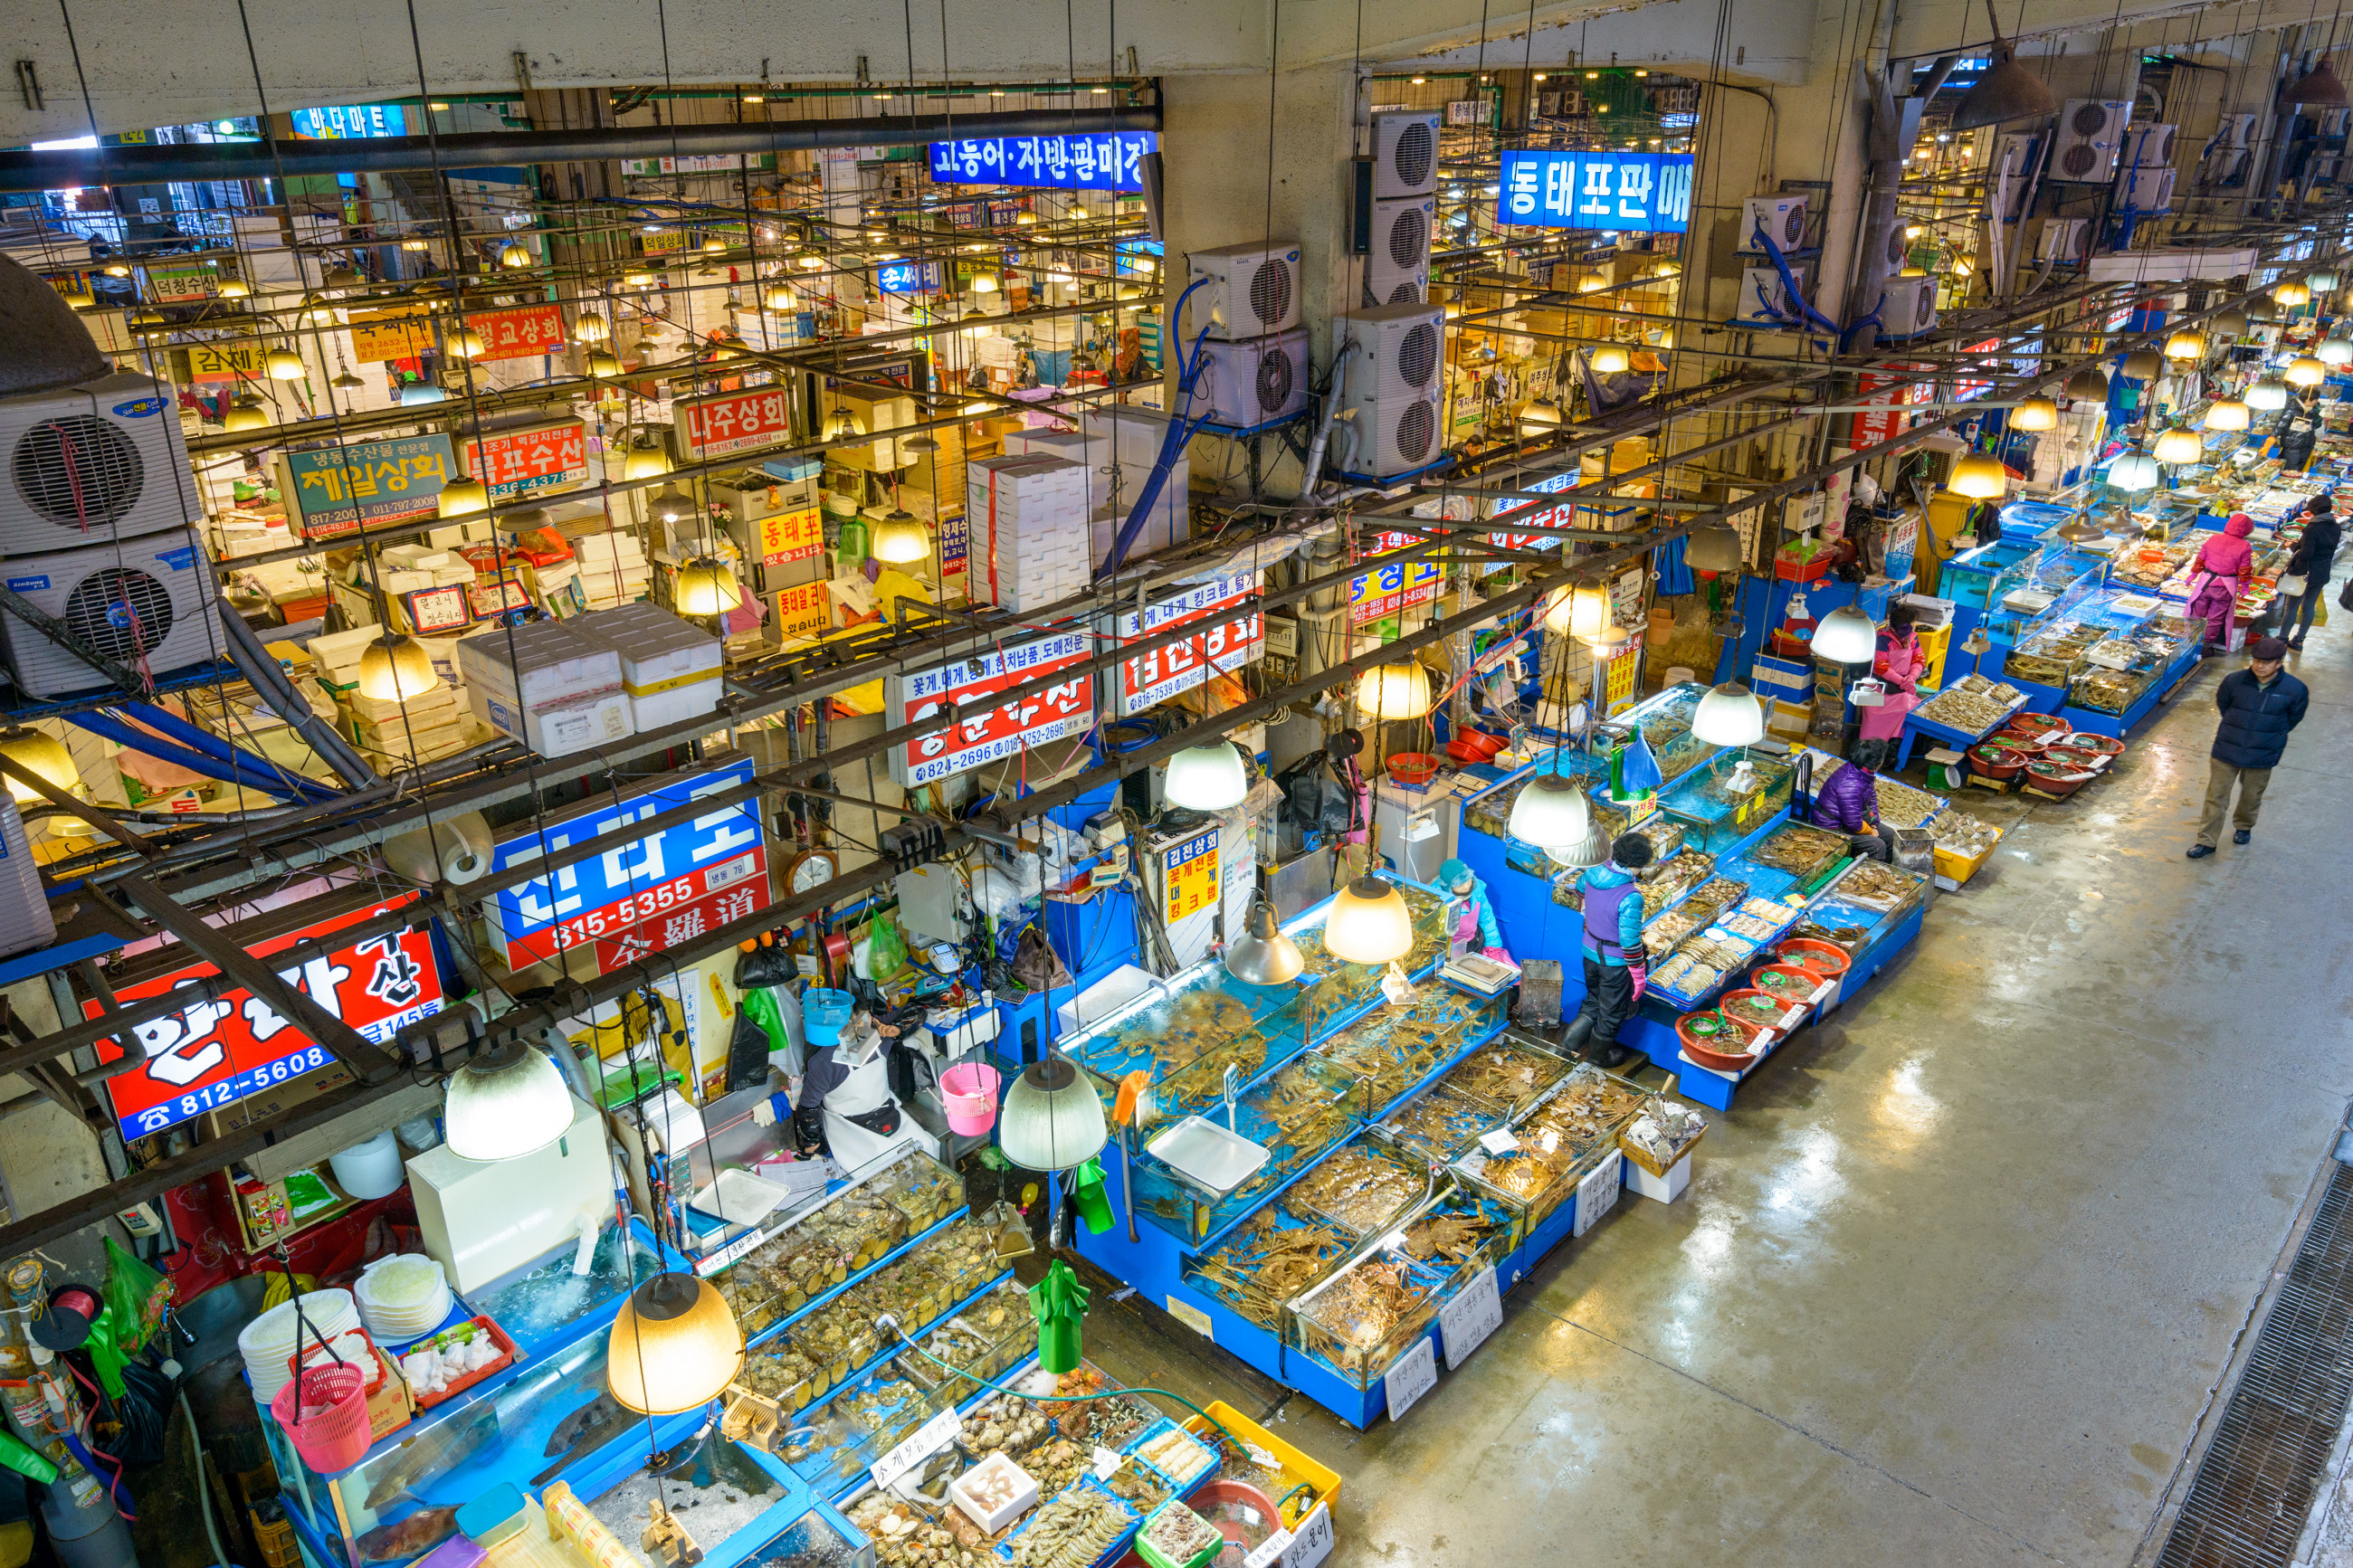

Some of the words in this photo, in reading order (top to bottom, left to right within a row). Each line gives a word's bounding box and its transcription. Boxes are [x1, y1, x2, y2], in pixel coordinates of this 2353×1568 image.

[309, 106, 389, 138] 바다마트
[1509, 160, 1693, 223] 동태포판매
[157, 275, 216, 296] 덕청수산
[473, 315, 560, 349] 벌교상회
[197, 349, 252, 373] 김제
[689, 394, 786, 440] 나주상회
[313, 444, 395, 467] 냉동수산물
[397, 442, 430, 454] 전문점
[472, 439, 584, 484] 목포수산
[300, 453, 448, 502] 제일상회
[373, 496, 436, 515] 011-797-2008
[764, 513, 820, 547] 동태포
[766, 544, 822, 566] 있습니다
[787, 615, 827, 634] 있습니다
[1138, 682, 1174, 708] 816-7539
[928, 746, 992, 778] 824-2696
[1169, 832, 1217, 866] 김천상회
[1169, 851, 1216, 885] 꽃게전문
[550, 878, 693, 950] 815-5355
[711, 870, 728, 885] 냉동
[734, 864, 744, 877] 79
[180, 1048, 325, 1117] 812-5608
